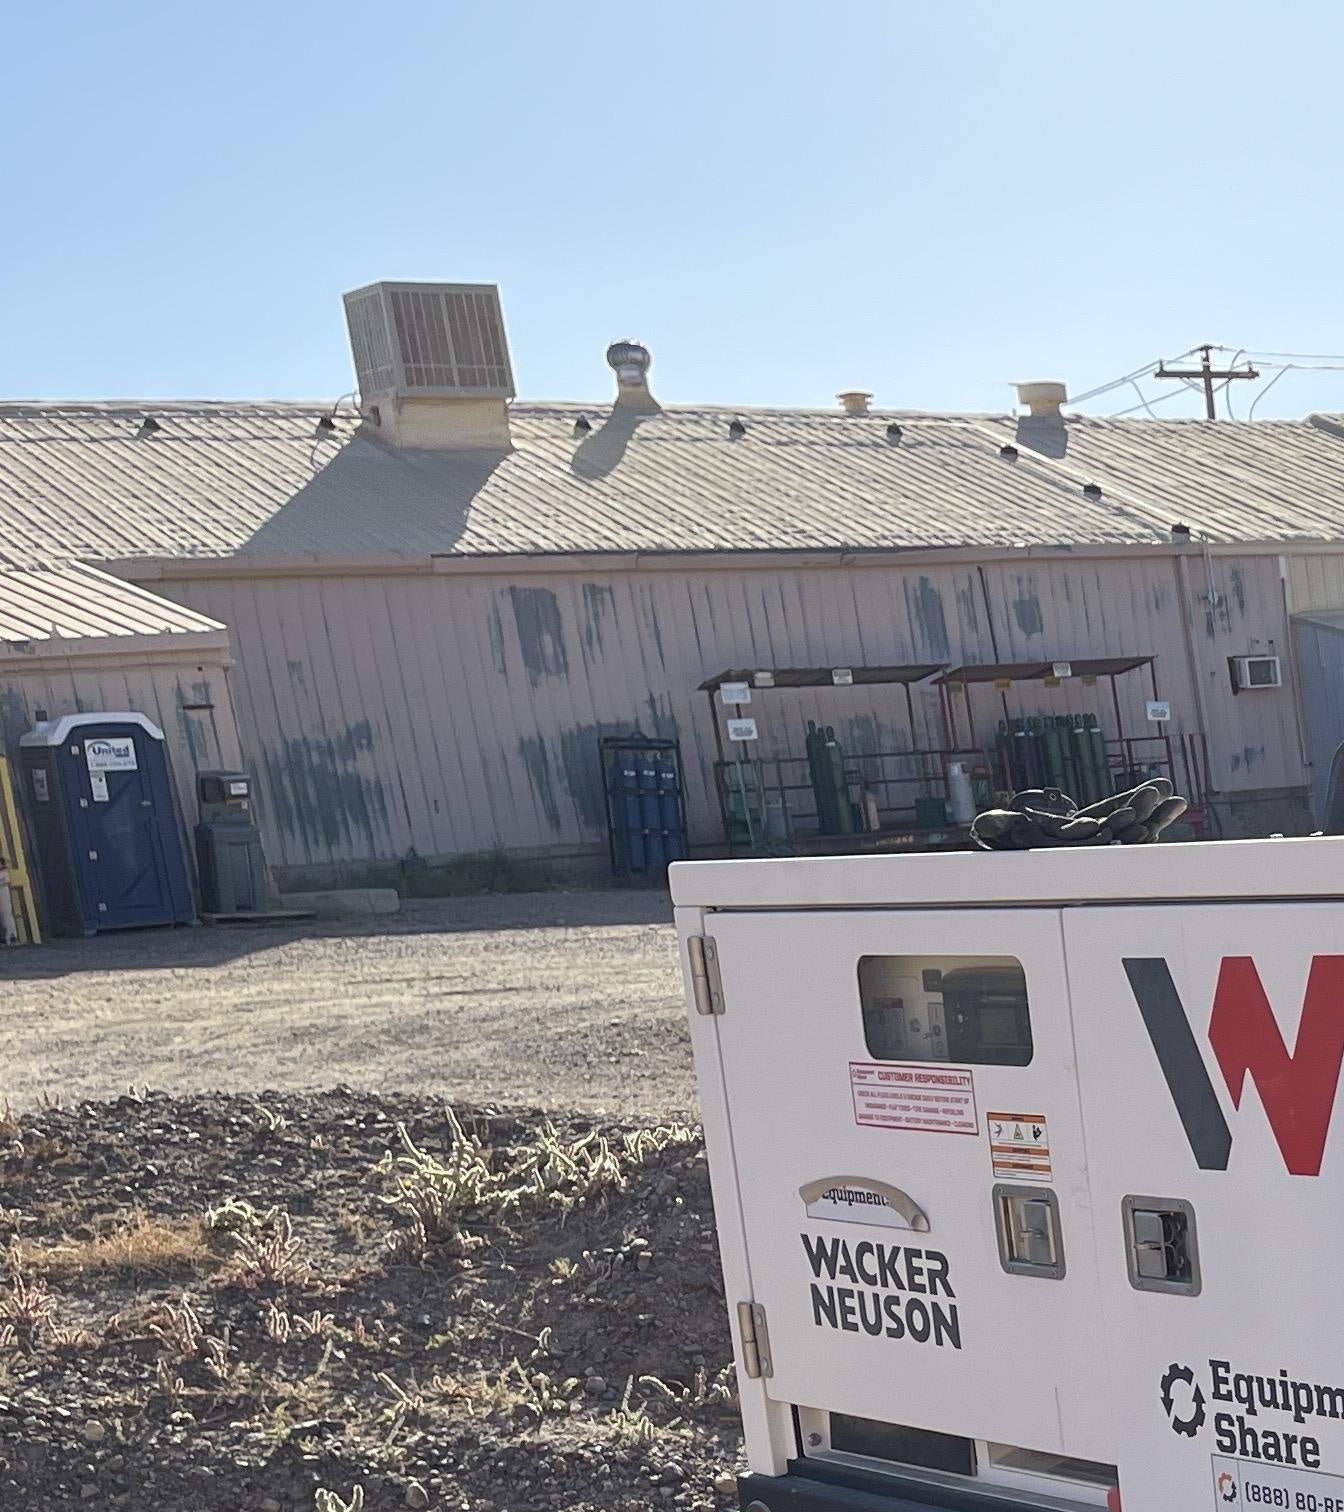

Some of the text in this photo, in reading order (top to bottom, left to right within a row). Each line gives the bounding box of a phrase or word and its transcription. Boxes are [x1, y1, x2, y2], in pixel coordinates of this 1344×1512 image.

[877, 1070, 914, 1082] CUSTOMER
[800, 1233, 956, 1298] WACKER
[810, 1283, 962, 1349] NEUSON
[1215, 1413, 1321, 1468] Share
[1244, 1480, 1291, 1511] (888)
